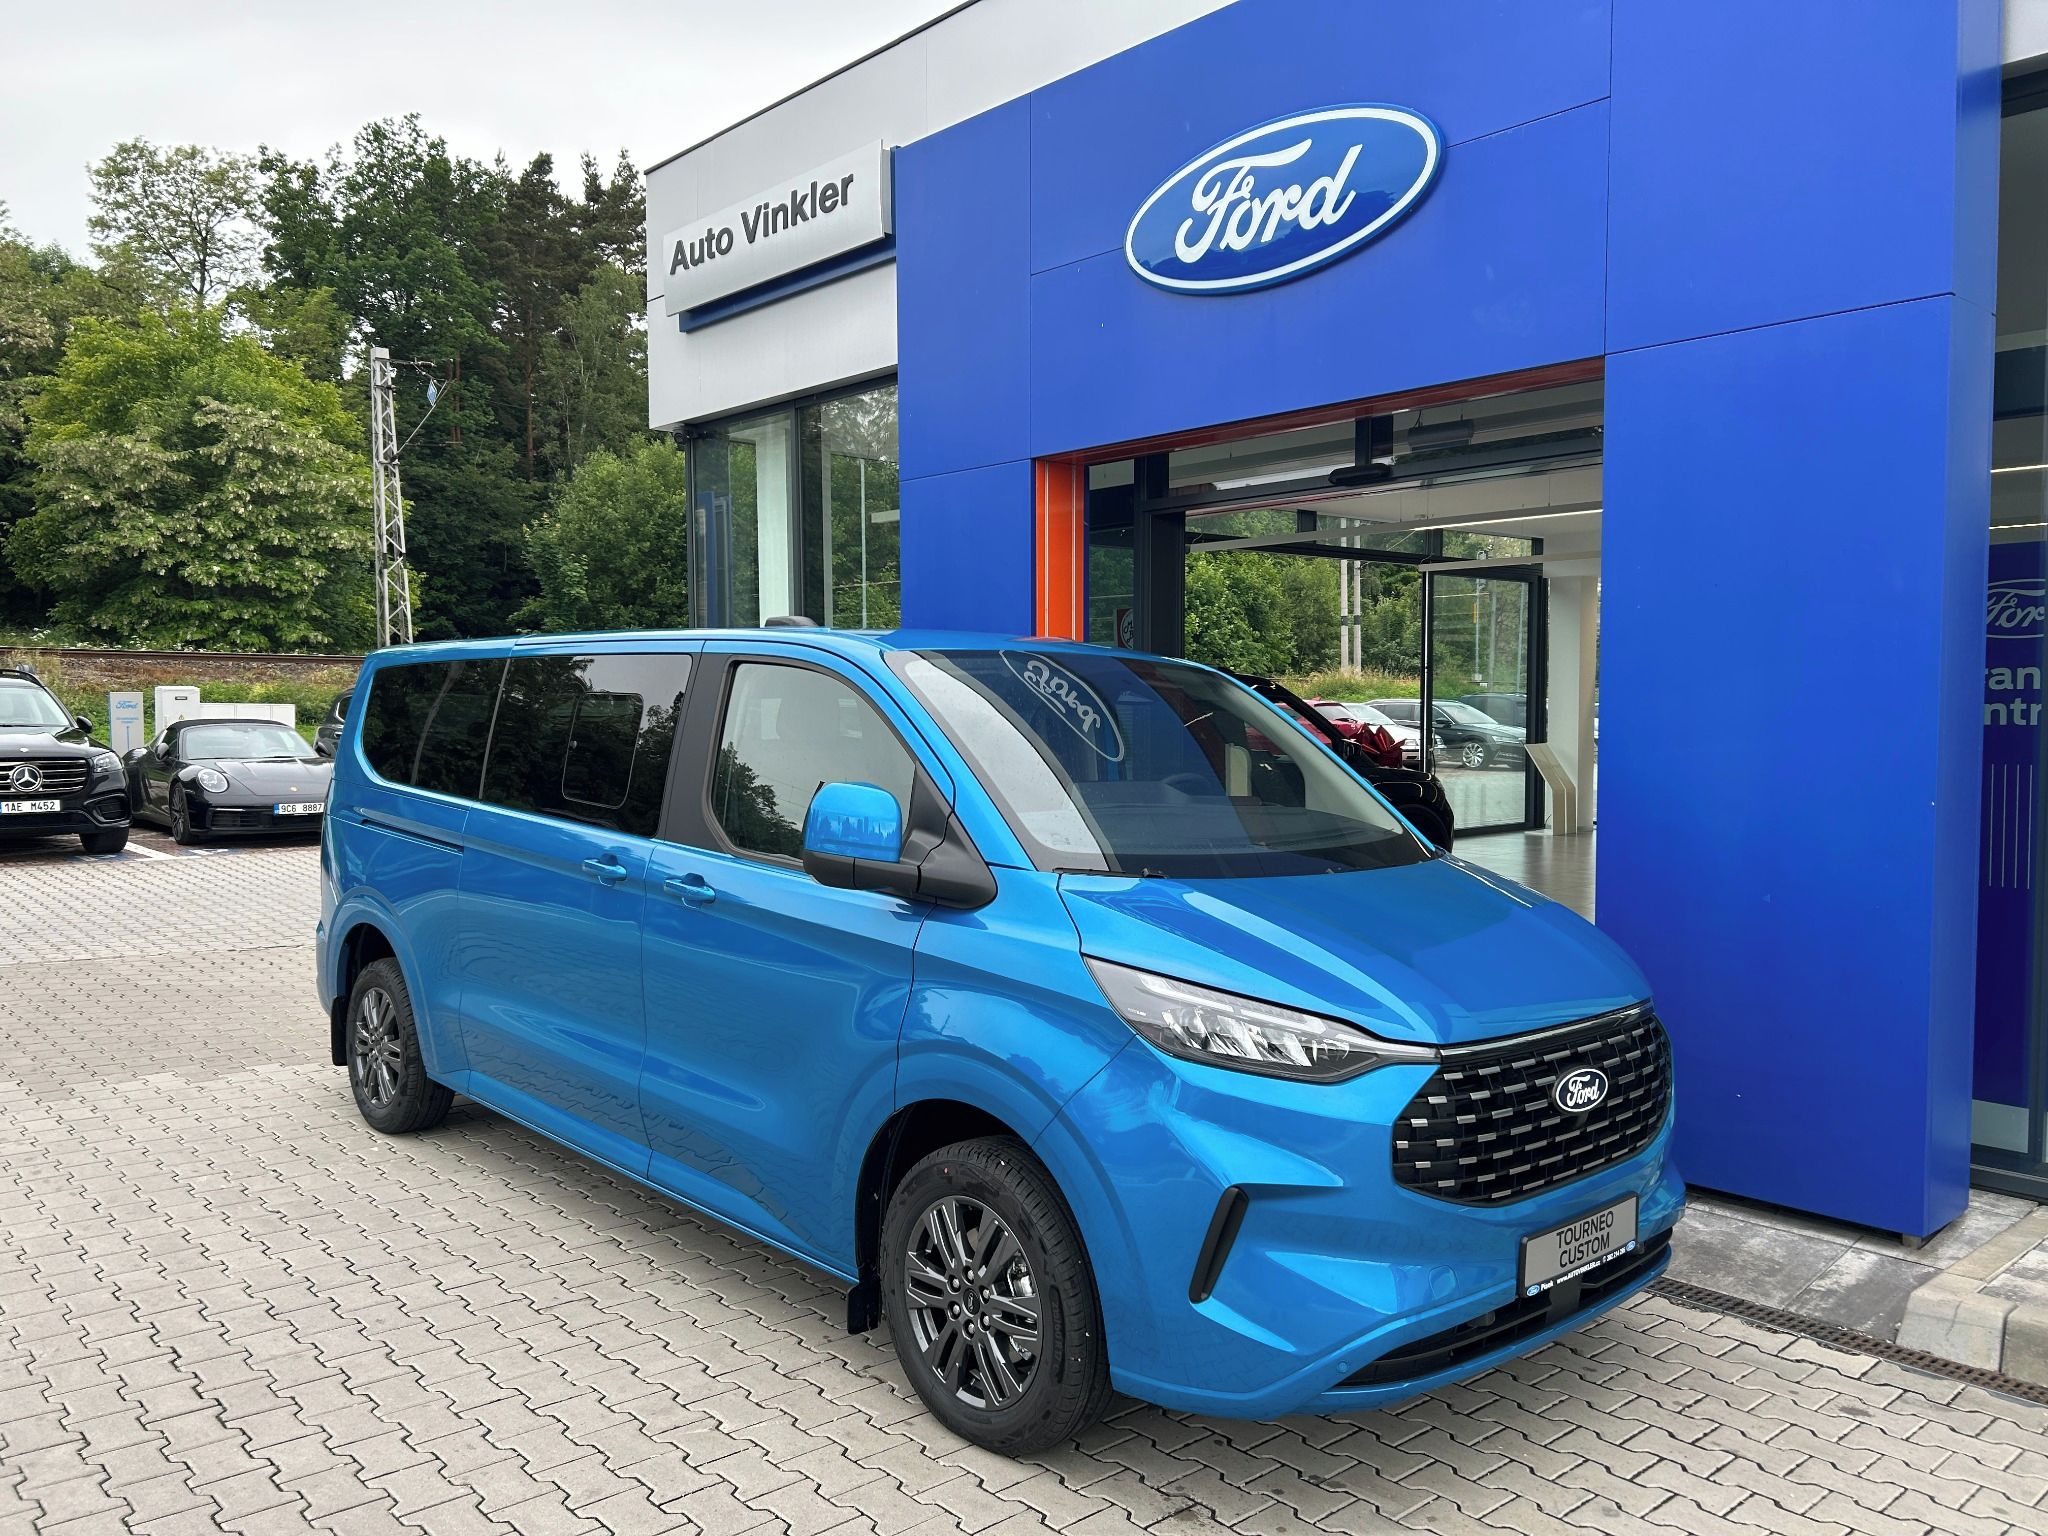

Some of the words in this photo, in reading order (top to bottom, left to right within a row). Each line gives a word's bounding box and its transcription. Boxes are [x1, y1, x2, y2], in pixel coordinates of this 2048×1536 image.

[1174, 138, 1363, 264] Ford
[669, 227, 734, 275] Auto
[740, 173, 854, 244] Vinkler
[1986, 588, 2046, 628] For
[1984, 666, 2041, 690] an
[4, 802, 23, 812] 1AE
[30, 801, 56, 811] M452
[280, 804, 297, 813] 9C6
[302, 803, 323, 812] 8887
[1566, 1074, 1600, 1107] Ford
[1556, 1210, 1614, 1249] TOURNEO
[1559, 1233, 1611, 1269] CUSTOM
